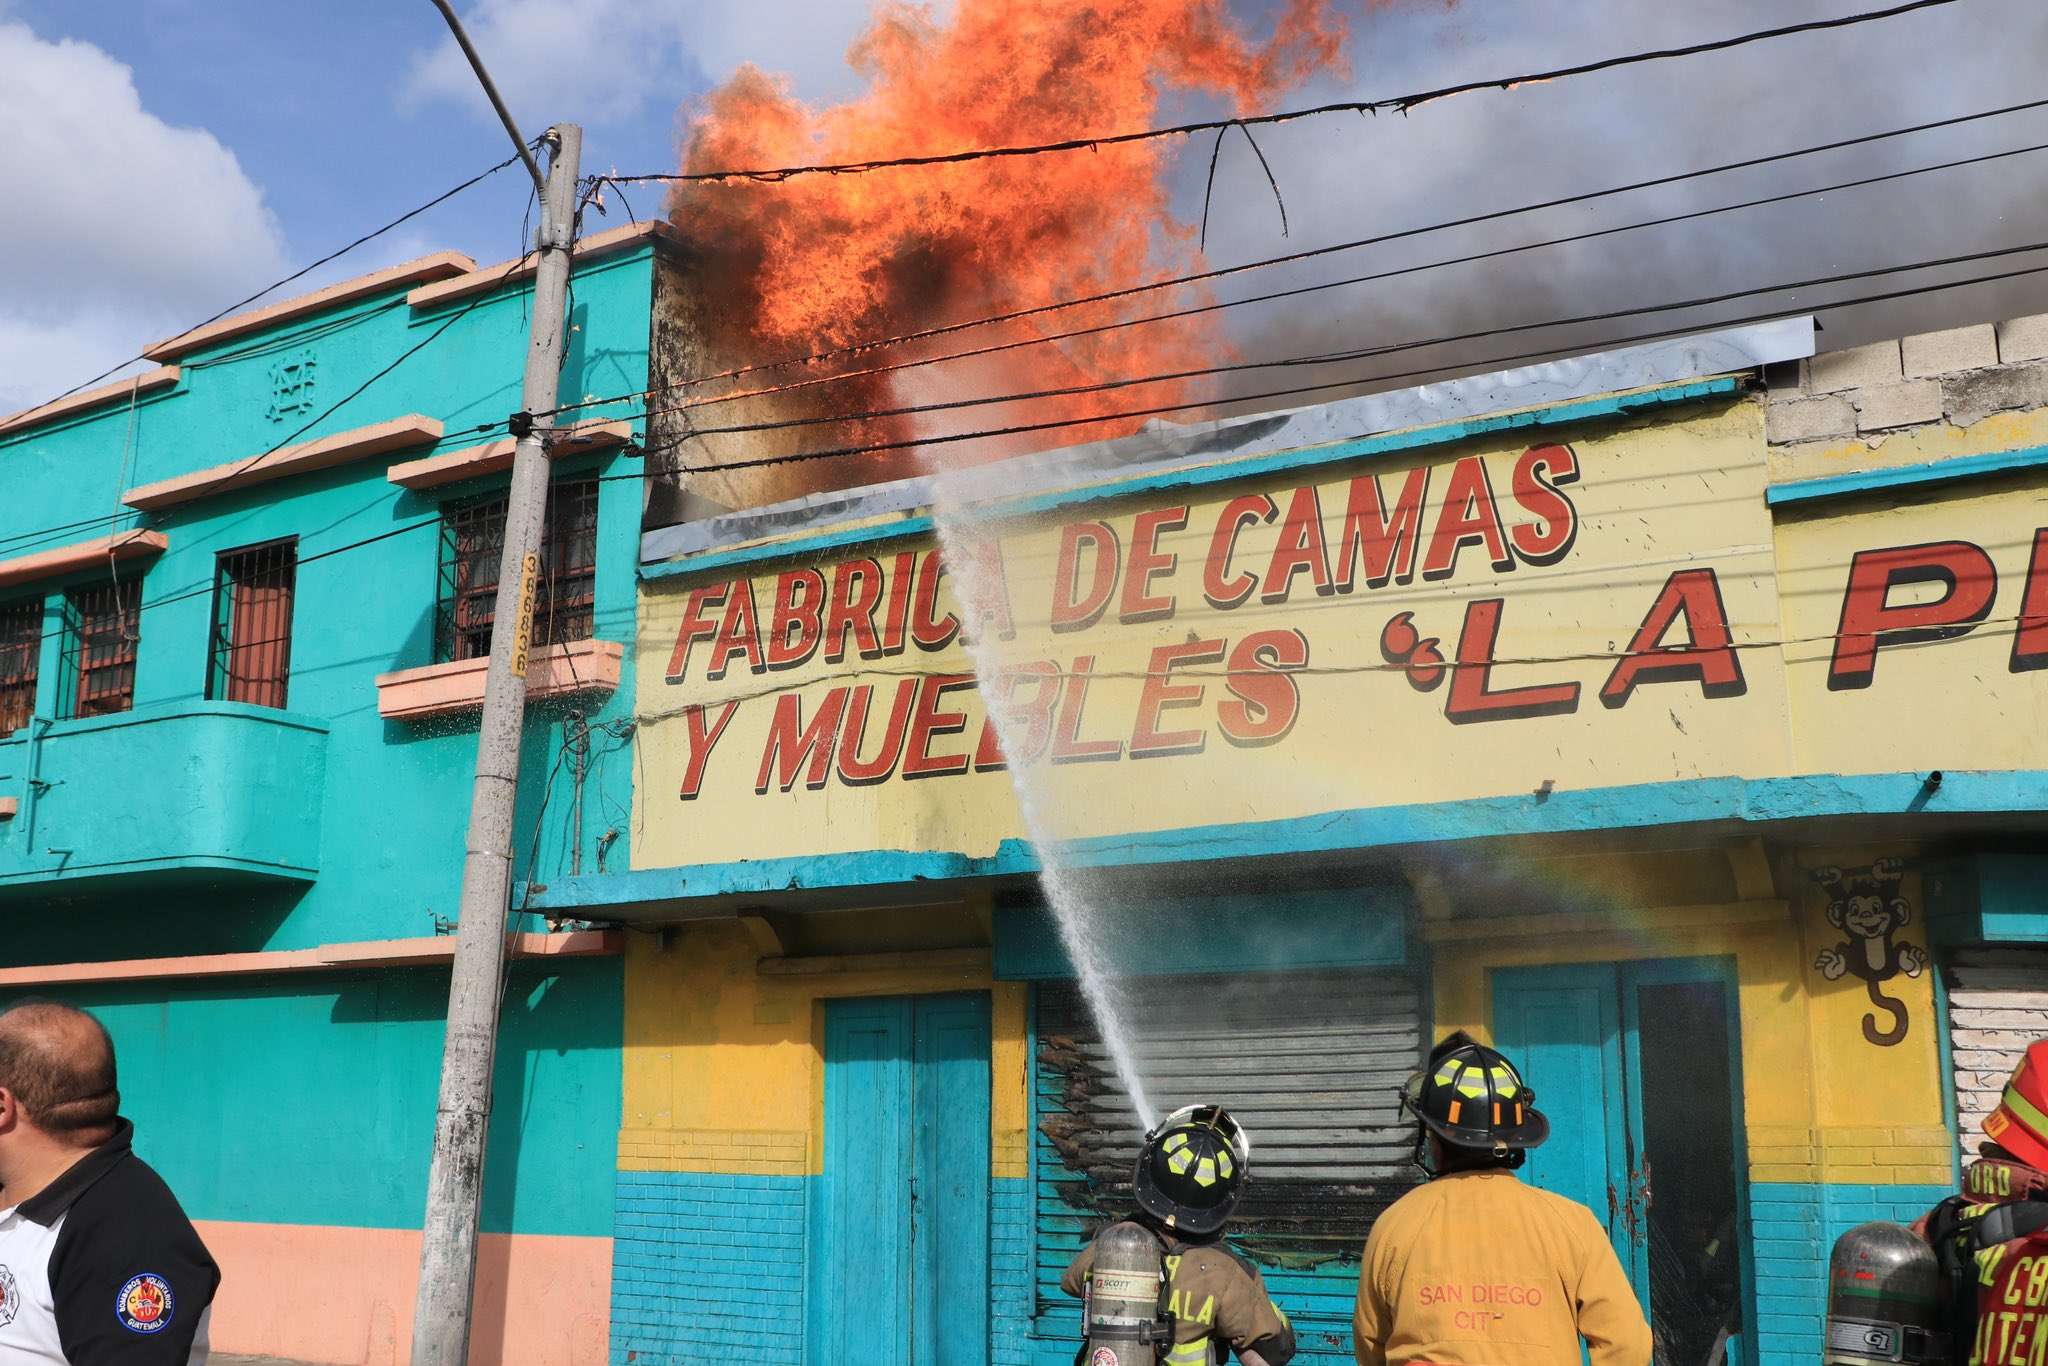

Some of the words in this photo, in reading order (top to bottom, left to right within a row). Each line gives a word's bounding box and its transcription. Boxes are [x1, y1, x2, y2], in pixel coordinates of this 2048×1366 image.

[665, 537, 1016, 684] FABRICA
[1051, 506, 1190, 634] DE
[1203, 442, 1581, 610] CAMAS
[680, 701, 742, 801] Y
[755, 628, 1310, 795] MUEBLES
[119, 1279, 142, 1312] BOMBEROS
[1103, 1280, 1130, 1288] SCOTT
[1420, 1284, 1462, 1306] SAN
[1472, 1284, 1542, 1307] DIEGO
[2004, 1255, 2048, 1307] CB
[127, 1317, 165, 1331] GUATEMALA
